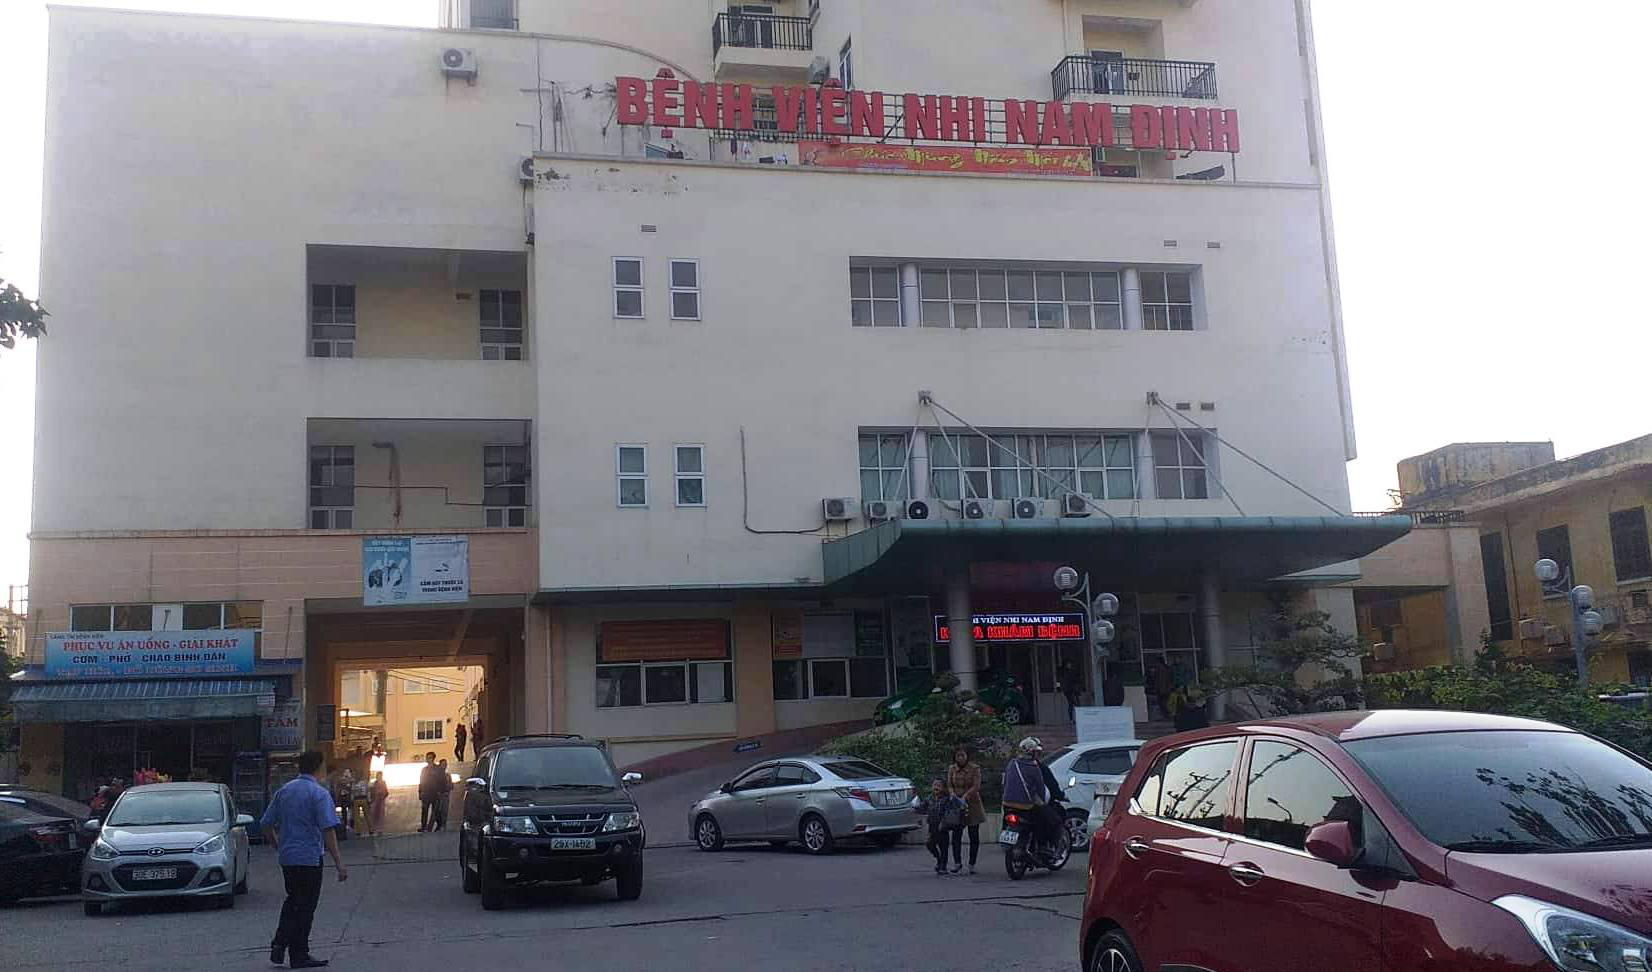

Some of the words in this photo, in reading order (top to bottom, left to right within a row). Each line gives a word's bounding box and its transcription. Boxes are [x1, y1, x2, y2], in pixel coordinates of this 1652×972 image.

[616, 67, 752, 139] BỆNH
[772, 78, 884, 145] VIỆN
[904, 93, 985, 142] NHI
[1004, 99, 1113, 146] NAM
[1131, 103, 1240, 160] ĐỊNH
[982, 616, 1002, 625] VIỆN
[1004, 616, 1020, 624] NHI
